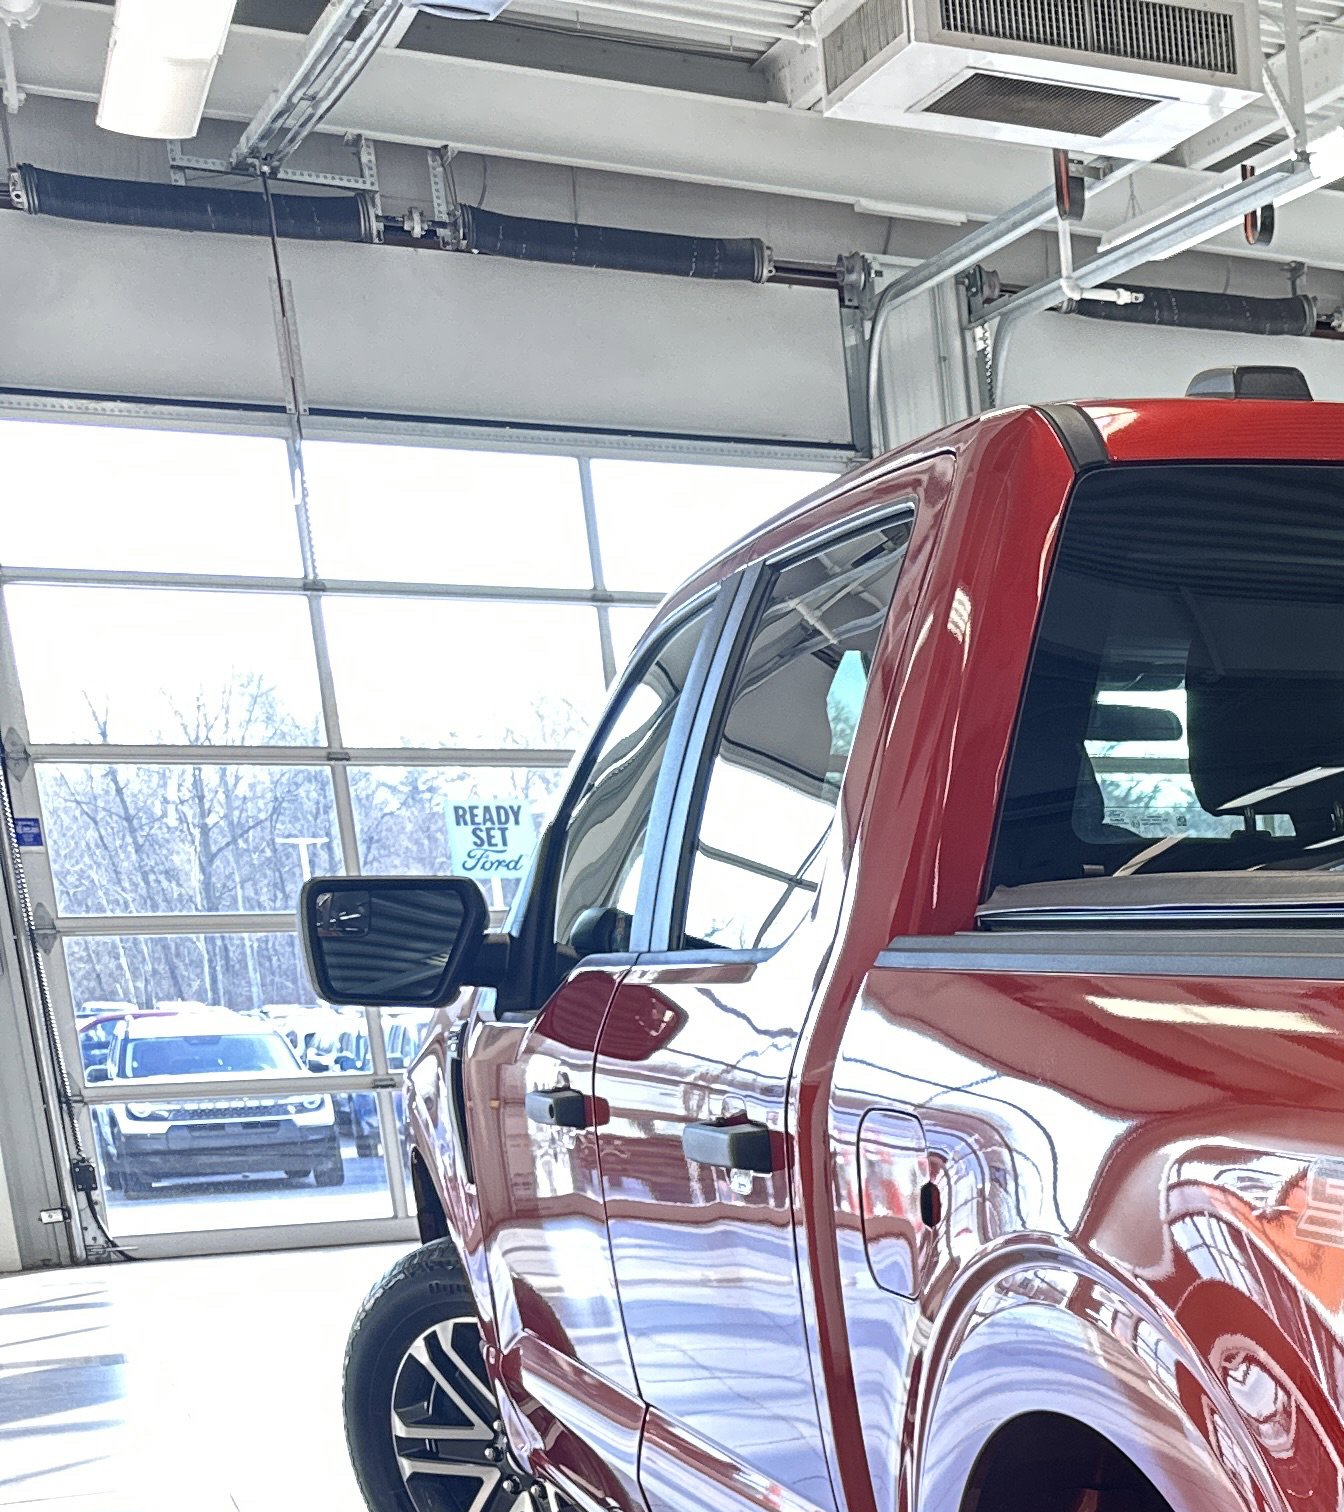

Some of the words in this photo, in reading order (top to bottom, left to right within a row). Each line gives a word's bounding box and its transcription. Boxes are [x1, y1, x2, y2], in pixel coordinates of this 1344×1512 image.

[453, 805, 522, 826] READY
[471, 827, 509, 848] SET
[462, 848, 524, 872] Ford
